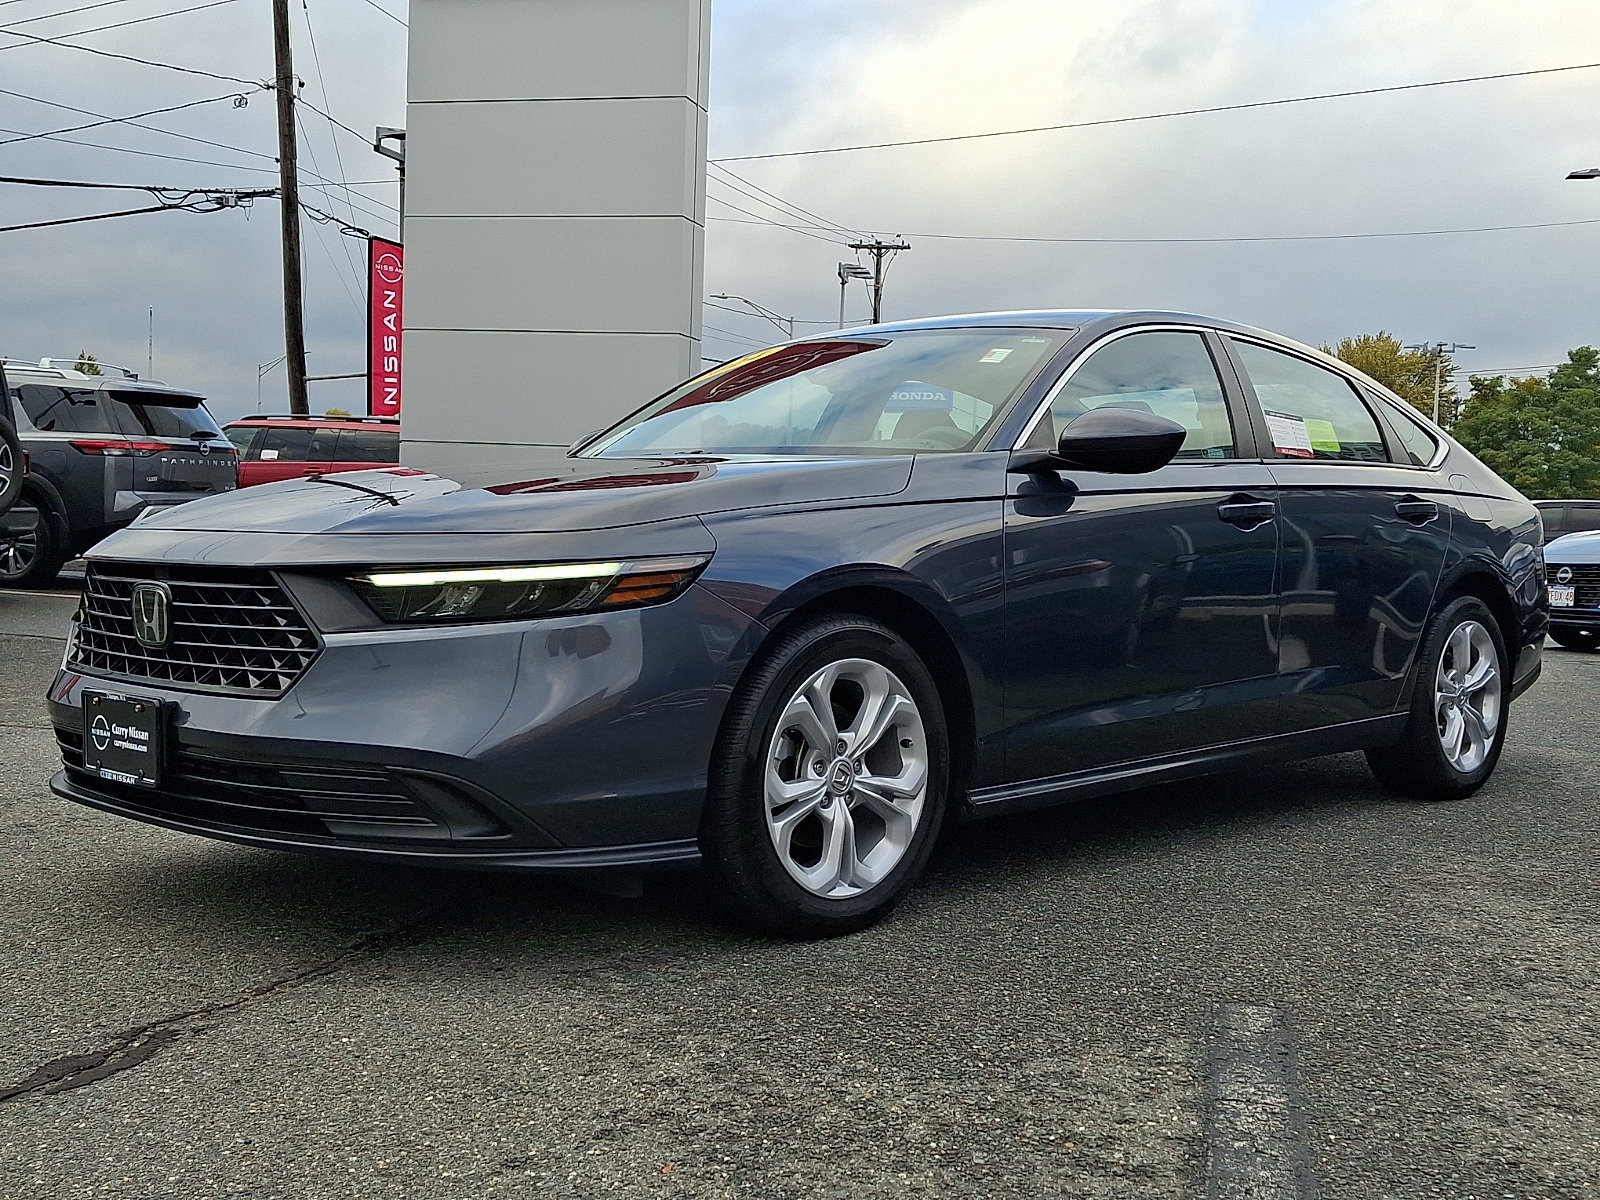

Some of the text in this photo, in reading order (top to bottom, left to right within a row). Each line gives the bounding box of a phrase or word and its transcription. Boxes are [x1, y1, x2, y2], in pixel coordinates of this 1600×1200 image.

[375, 263, 403, 274] NISSAN
[383, 290, 398, 405] NISSAN
[889, 391, 947, 401] HONDA
[91, 727, 111, 737] NISSAN
[111, 723, 149, 741] Curry Nissan
[112, 775, 136, 785] NISSAN
